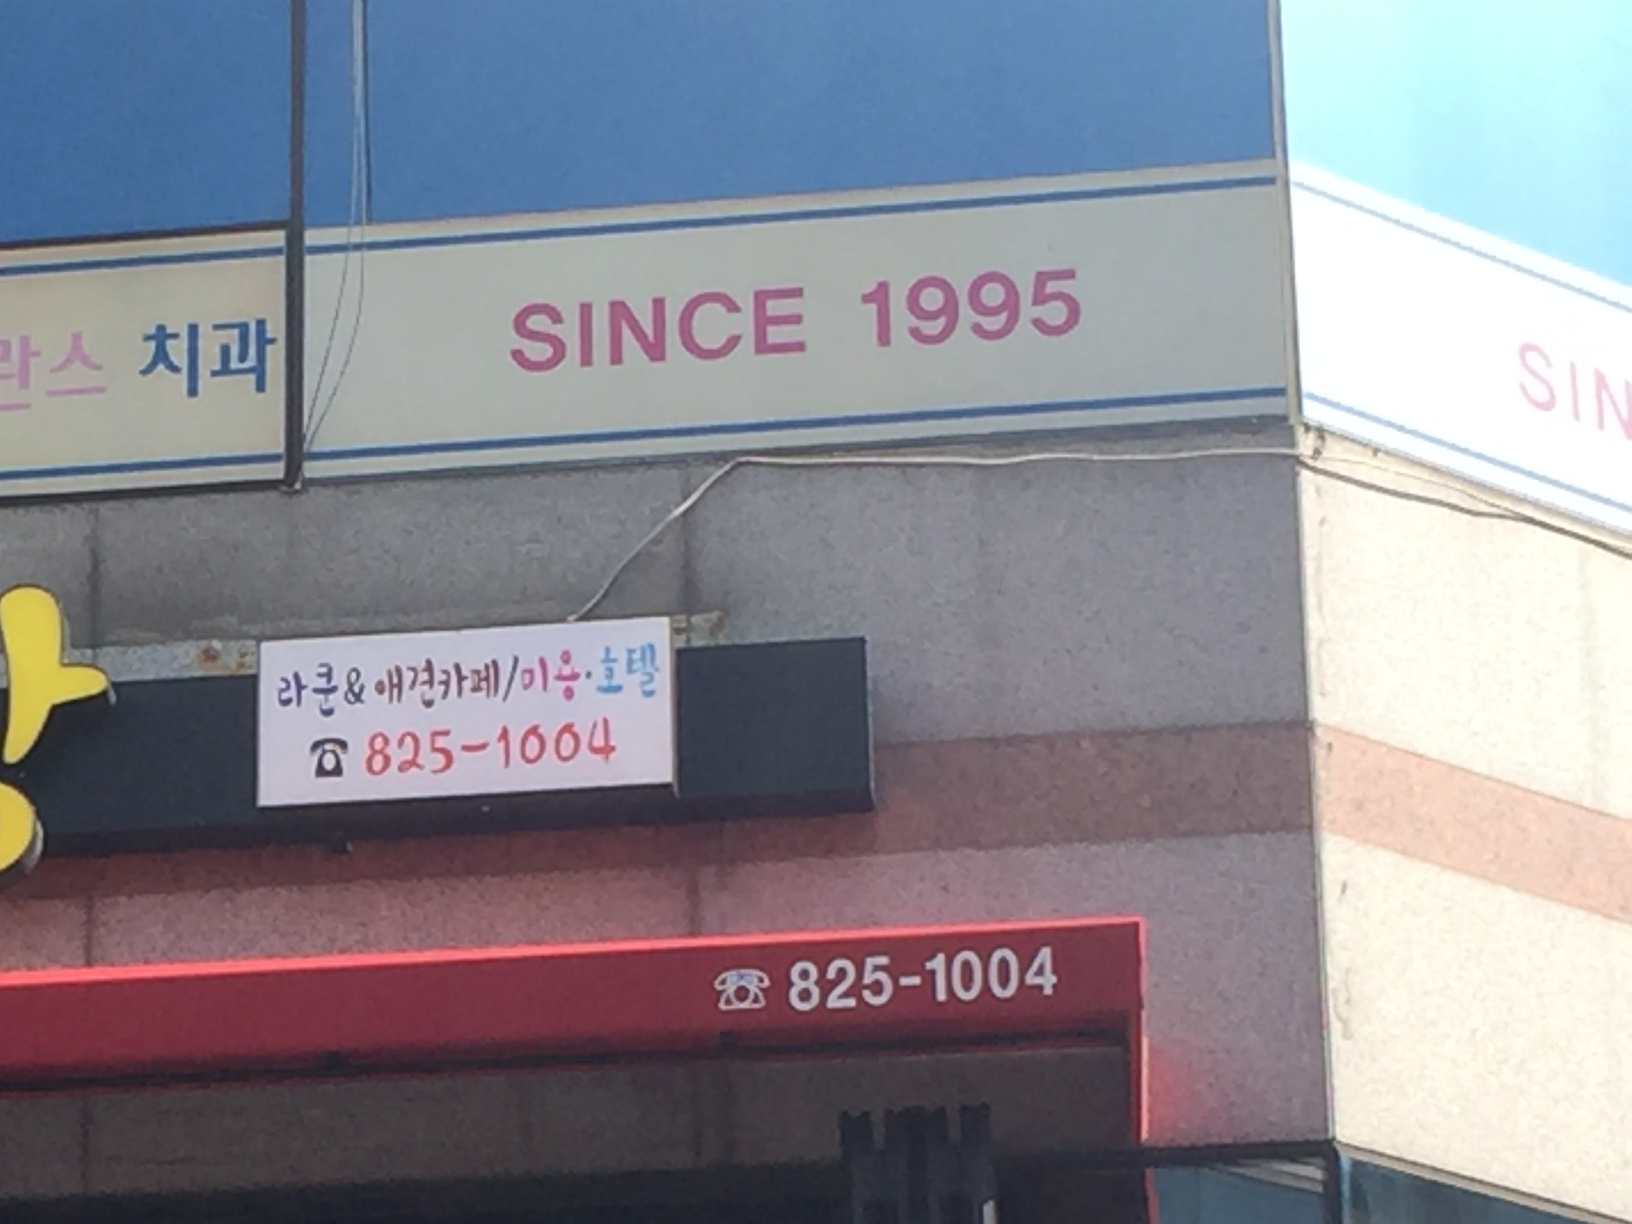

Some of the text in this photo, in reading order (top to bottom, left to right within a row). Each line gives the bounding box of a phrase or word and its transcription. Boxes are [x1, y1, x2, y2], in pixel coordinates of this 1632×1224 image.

[510, 268, 1081, 372] SINCE 1995
[138, 317, 279, 399] 치과
[364, 717, 617, 777] 825-1004
[788, 945, 1058, 1012] 825-1004
